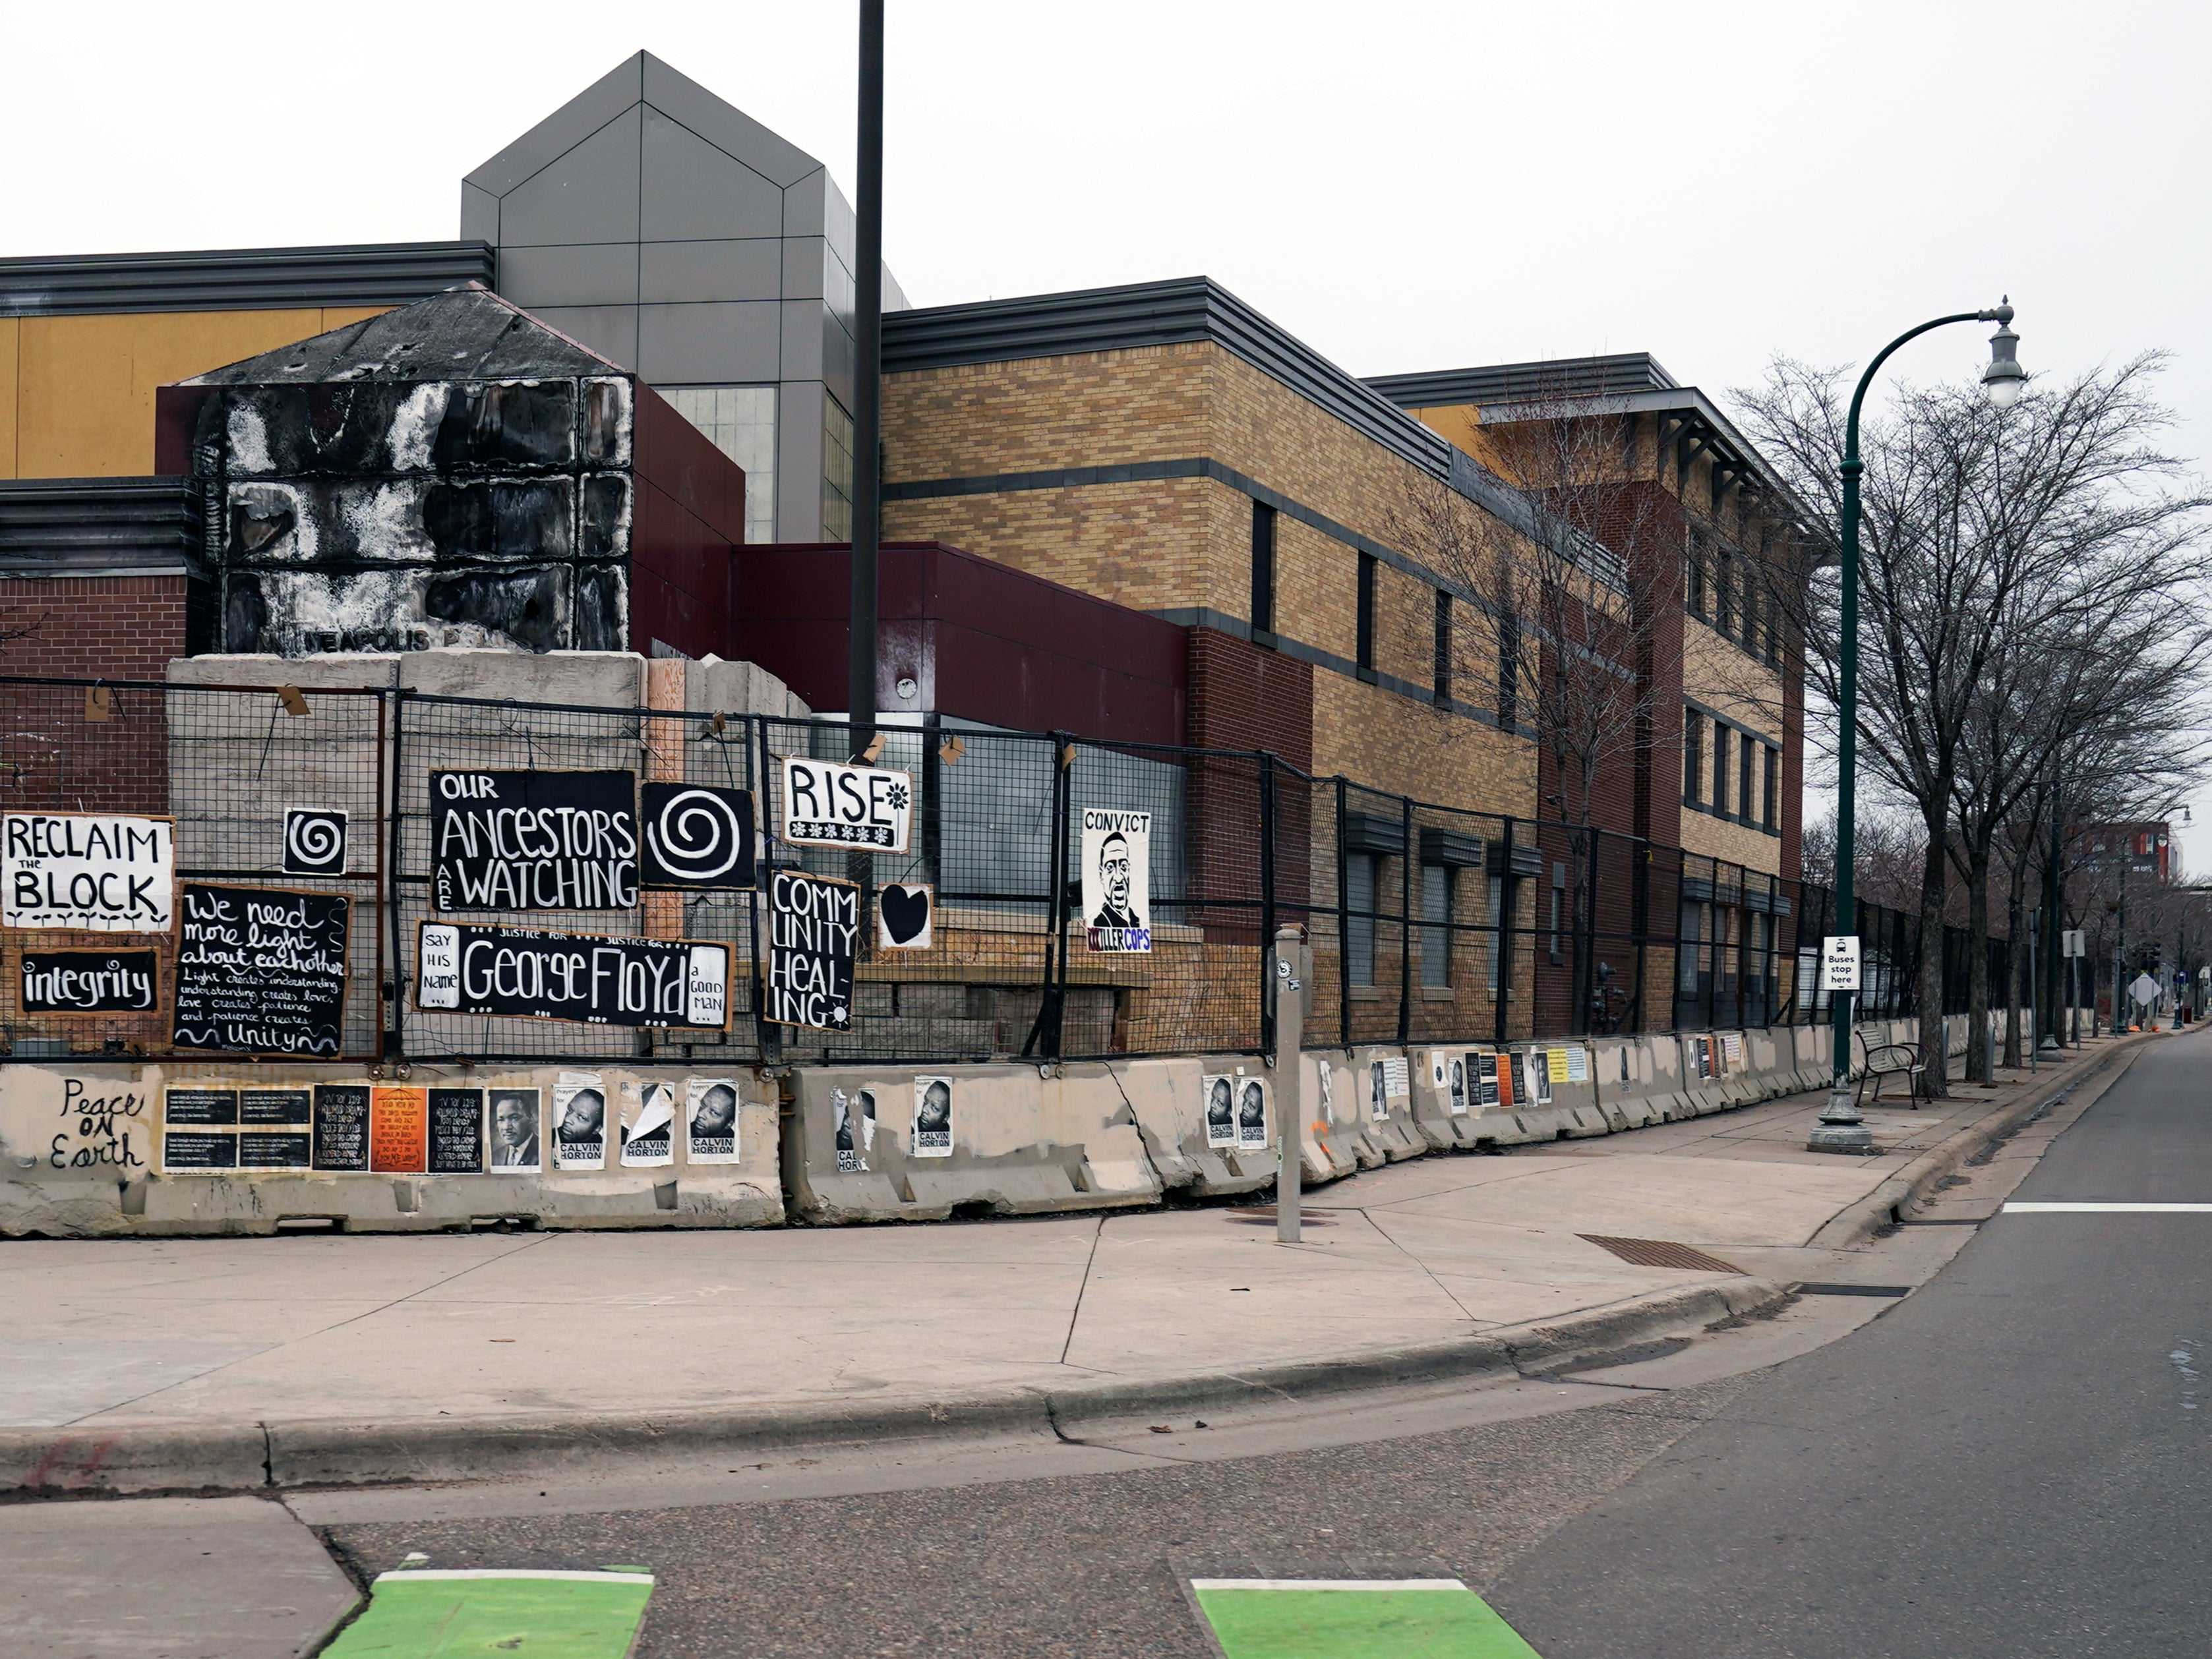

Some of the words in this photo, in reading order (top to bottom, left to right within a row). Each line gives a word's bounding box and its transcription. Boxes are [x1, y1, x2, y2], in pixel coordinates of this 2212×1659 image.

[440, 774, 500, 800] OUR
[791, 765, 893, 826] RISE
[8, 817, 158, 863] RECLAIM
[1085, 811, 1149, 833] CONVICT
[15, 871, 158, 915] BLOCK
[436, 864, 452, 910] ARE
[456, 858, 638, 908] WATCHING
[773, 874, 856, 925] COMM
[185, 892, 239, 921] We
[247, 898, 324, 929] need
[185, 923, 243, 946] more
[246, 922, 317, 959] light
[771, 911, 858, 956] UNITY
[1124, 929, 1151, 951] COPS
[181, 944, 252, 966] about
[427, 954, 450, 967] HIS
[22, 960, 152, 1008] integrity
[181, 985, 258, 1004] understanding
[262, 990, 298, 1001] creates
[183, 967, 220, 985] Light
[226, 975, 264, 985] creates
[690, 980, 723, 993] GOOD
[177, 995, 202, 1008] love
[212, 999, 251, 1009] creates
[258, 1001, 312, 1015] patience
[181, 1010, 203, 1021] and
[208, 1012, 260, 1026] patience
[265, 1015, 313, 1024] creates
[774, 986, 828, 1028] ING
[228, 1024, 295, 1052] Unity
[60, 1079, 145, 1117] Peace
[51, 1132, 144, 1169] Earth
[560, 1144, 601, 1152] CALVIN
